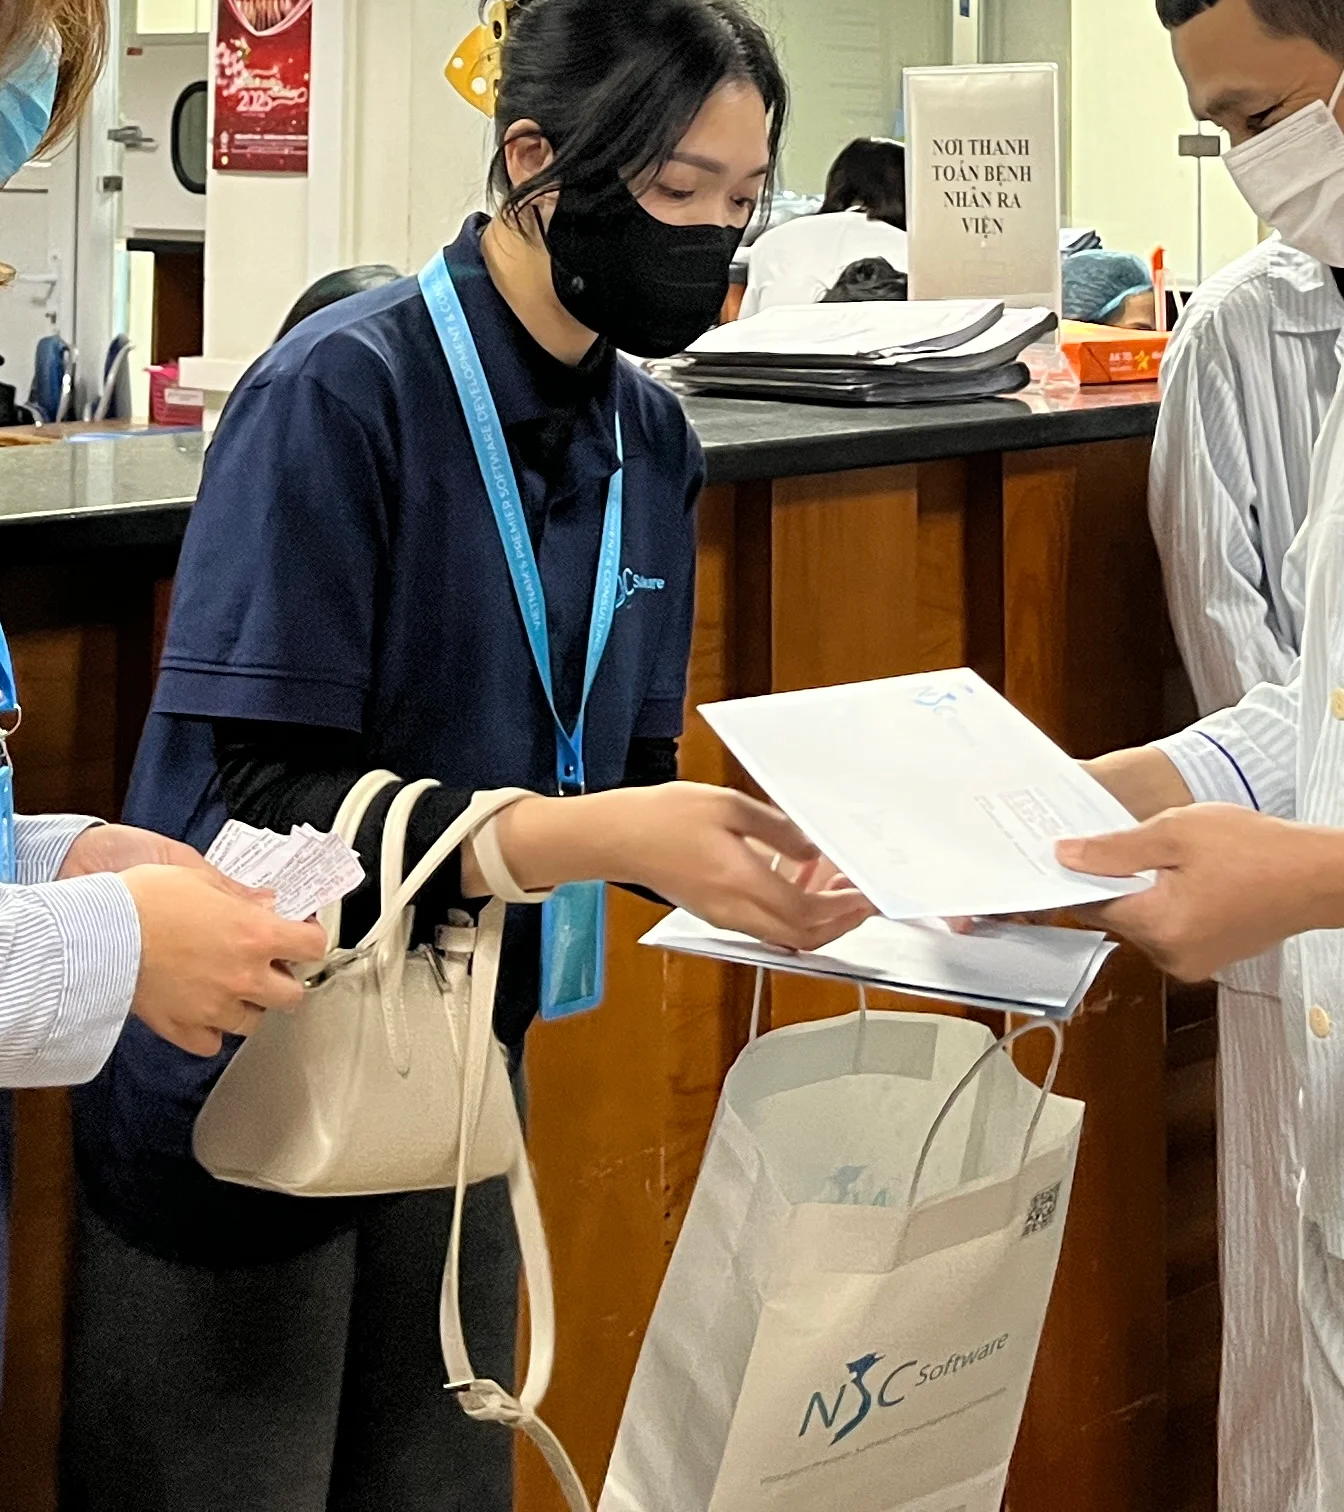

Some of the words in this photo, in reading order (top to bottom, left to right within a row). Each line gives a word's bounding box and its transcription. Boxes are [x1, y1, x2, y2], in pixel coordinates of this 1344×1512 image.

[932, 138, 964, 156] NƠI
[967, 138, 1030, 156] THANH
[931, 159, 979, 182] TOÁN
[984, 162, 1031, 187] BỆNH
[943, 185, 992, 208] NHÂN
[997, 191, 1021, 209] RA
[961, 215, 1004, 239] VIỆN
[447, 322, 489, 422] DEVELOPMENT
[481, 423, 510, 499] SOFTWARE
[502, 500, 525, 559] PREMIER
[915, 1332, 1009, 1387] Software
